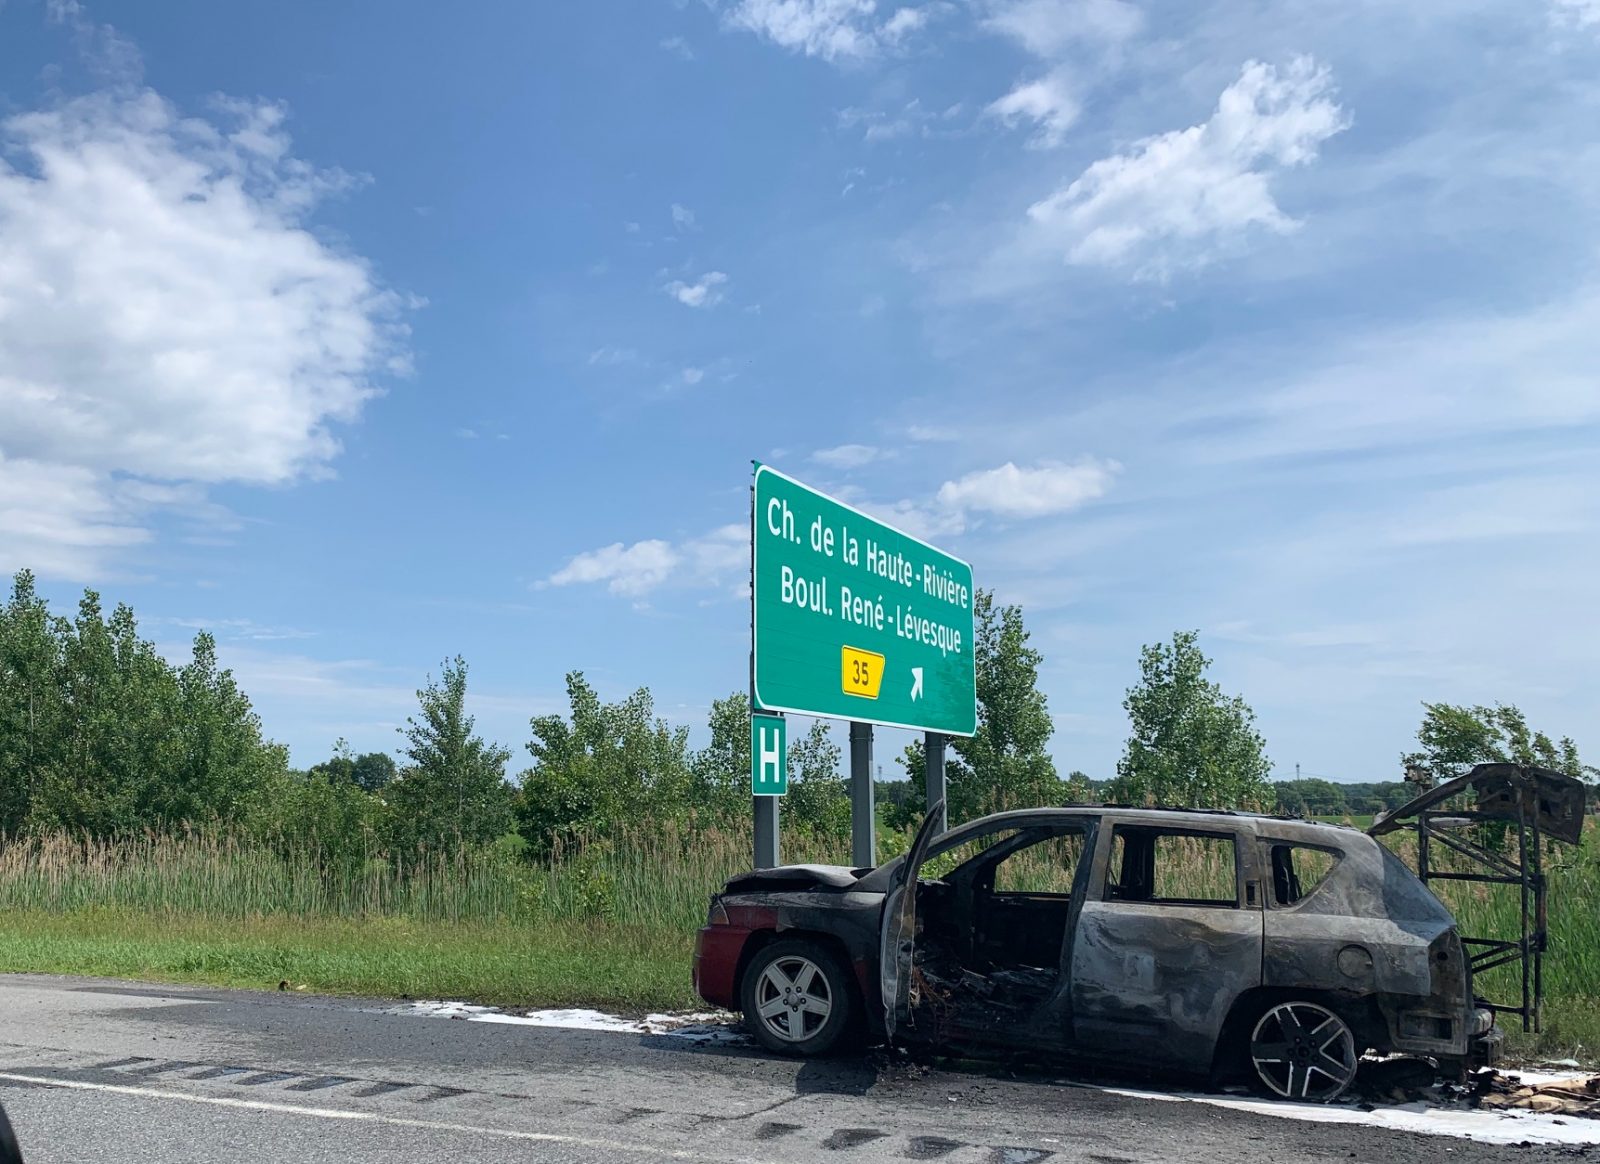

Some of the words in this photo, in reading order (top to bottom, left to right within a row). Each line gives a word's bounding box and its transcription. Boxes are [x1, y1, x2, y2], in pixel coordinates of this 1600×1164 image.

[767, 497, 801, 545] Ch.
[810, 515, 834, 557] de
[842, 526, 859, 567] la
[781, 565, 833, 616] Boul.
[852, 659, 869, 686] 35
[759, 727, 780, 783] H
